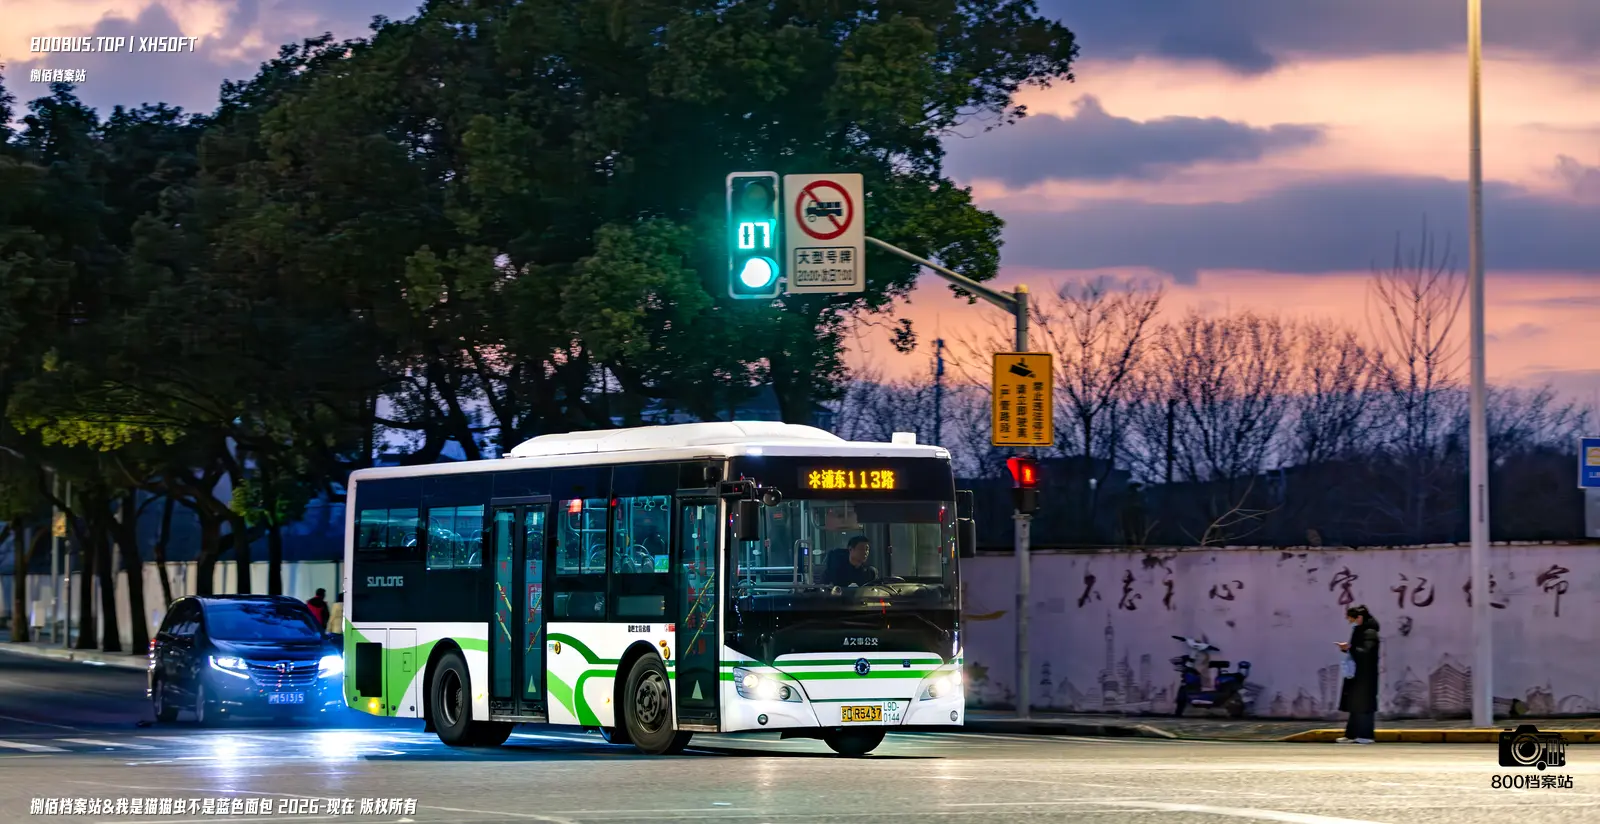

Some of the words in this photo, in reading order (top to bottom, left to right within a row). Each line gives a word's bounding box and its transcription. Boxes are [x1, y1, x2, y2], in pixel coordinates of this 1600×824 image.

[738, 221, 771, 249] 07
[797, 250, 852, 264] 大型号牌
[367, 575, 404, 587] SUNLONG
[883, 712, 900, 723] 0144
